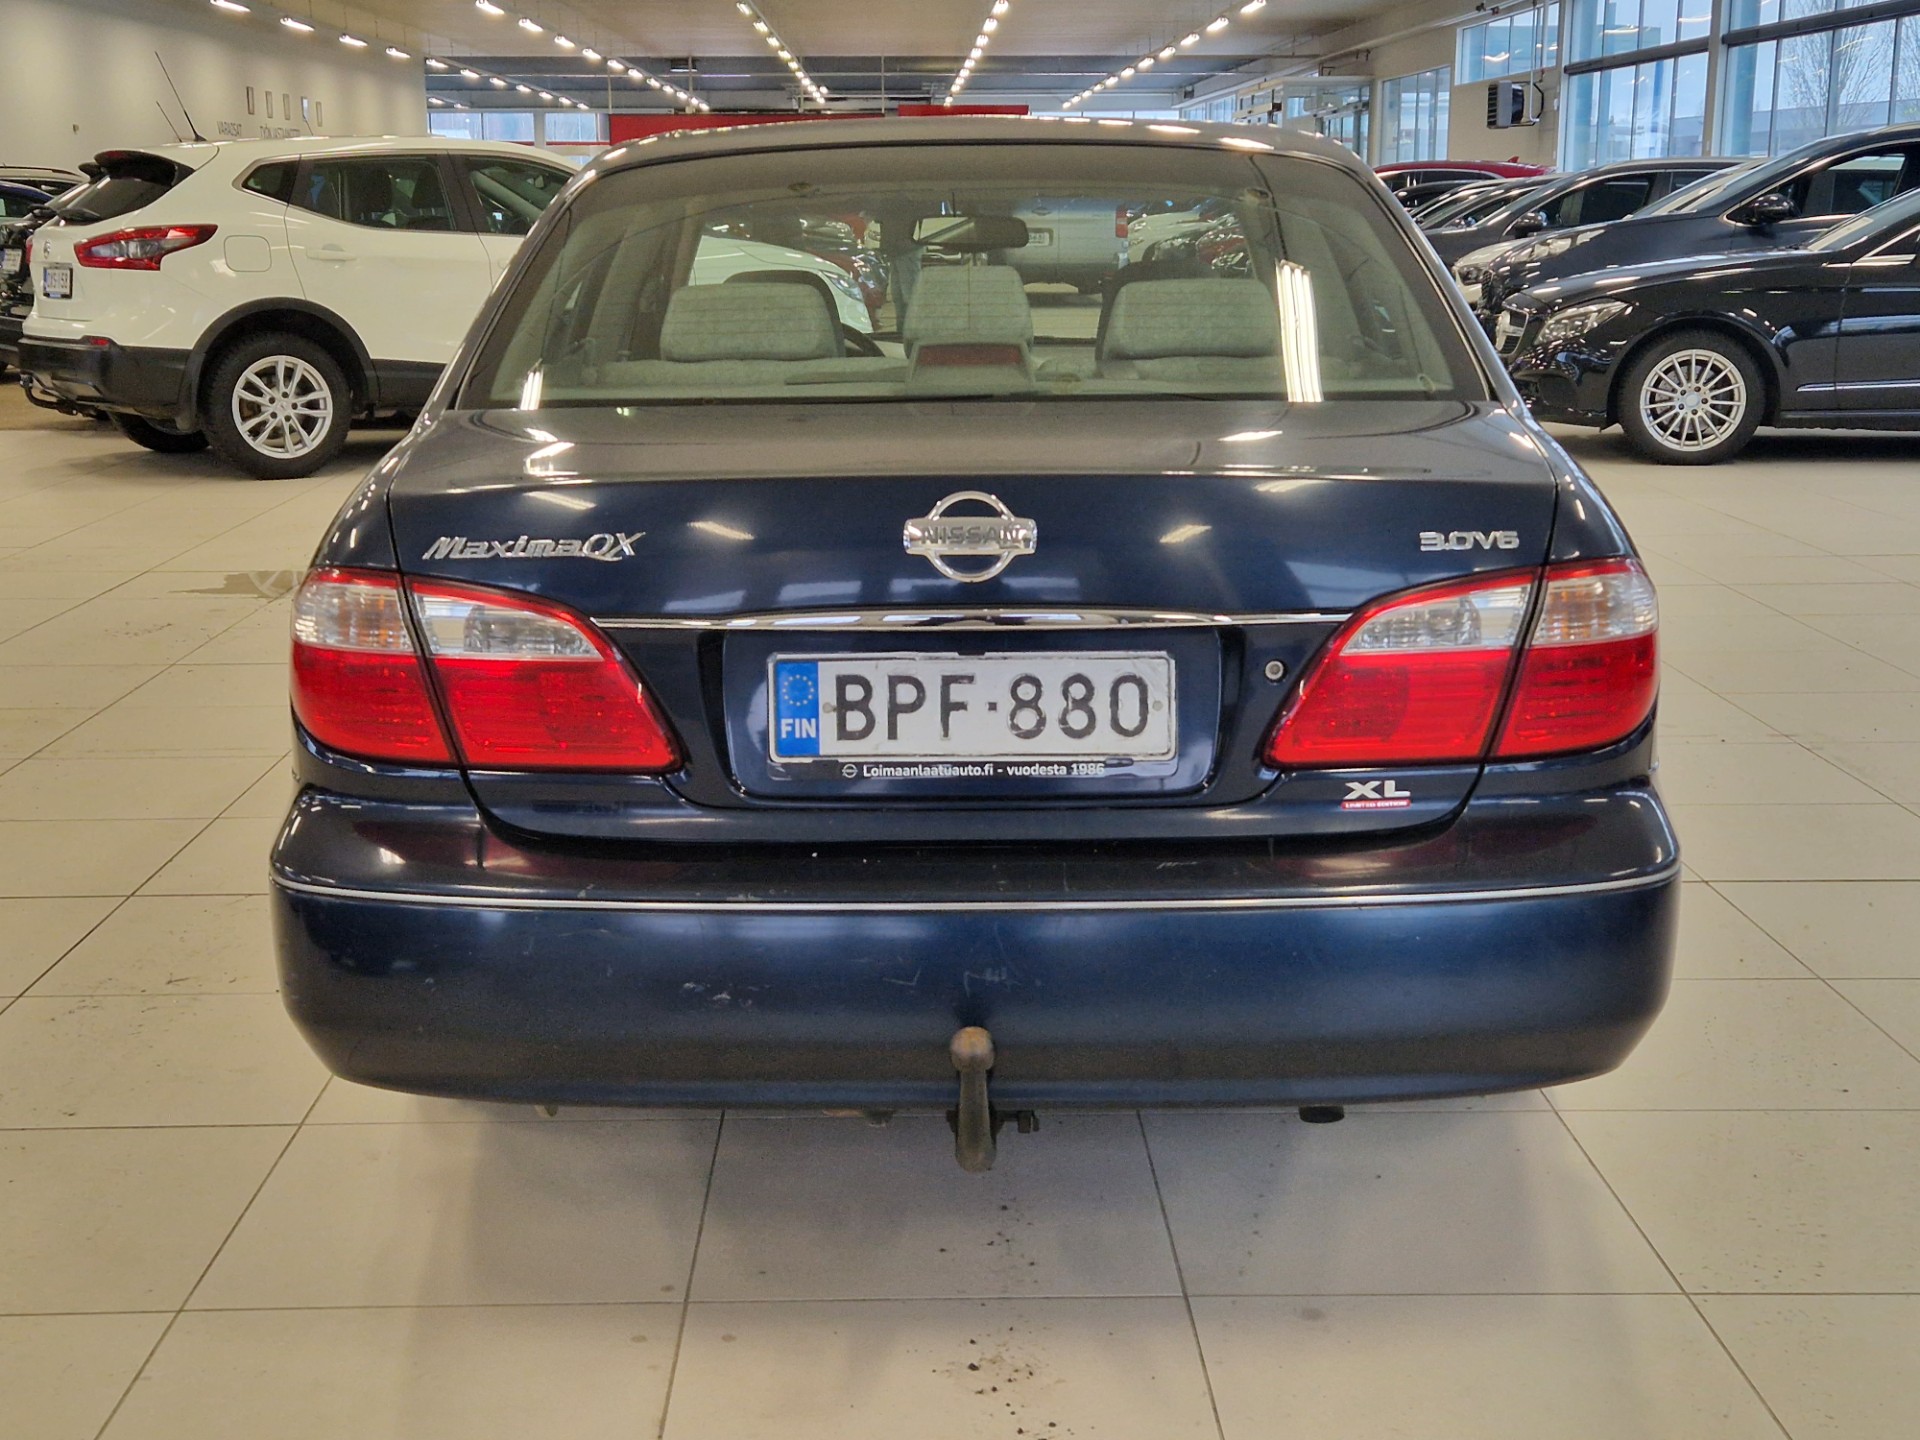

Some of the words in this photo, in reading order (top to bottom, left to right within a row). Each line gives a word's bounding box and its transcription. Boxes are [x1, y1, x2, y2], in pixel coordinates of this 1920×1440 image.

[920, 525, 1026, 547] NISSAN
[834, 672, 1150, 741] BPF-880
[780, 717, 817, 739] FIN
[862, 763, 995, 778] Loimaanlaatuauto.fi
[1007, 764, 1067, 777] vuodesta
[1070, 763, 1106, 776] 1986
[1343, 779, 1411, 800] XL
